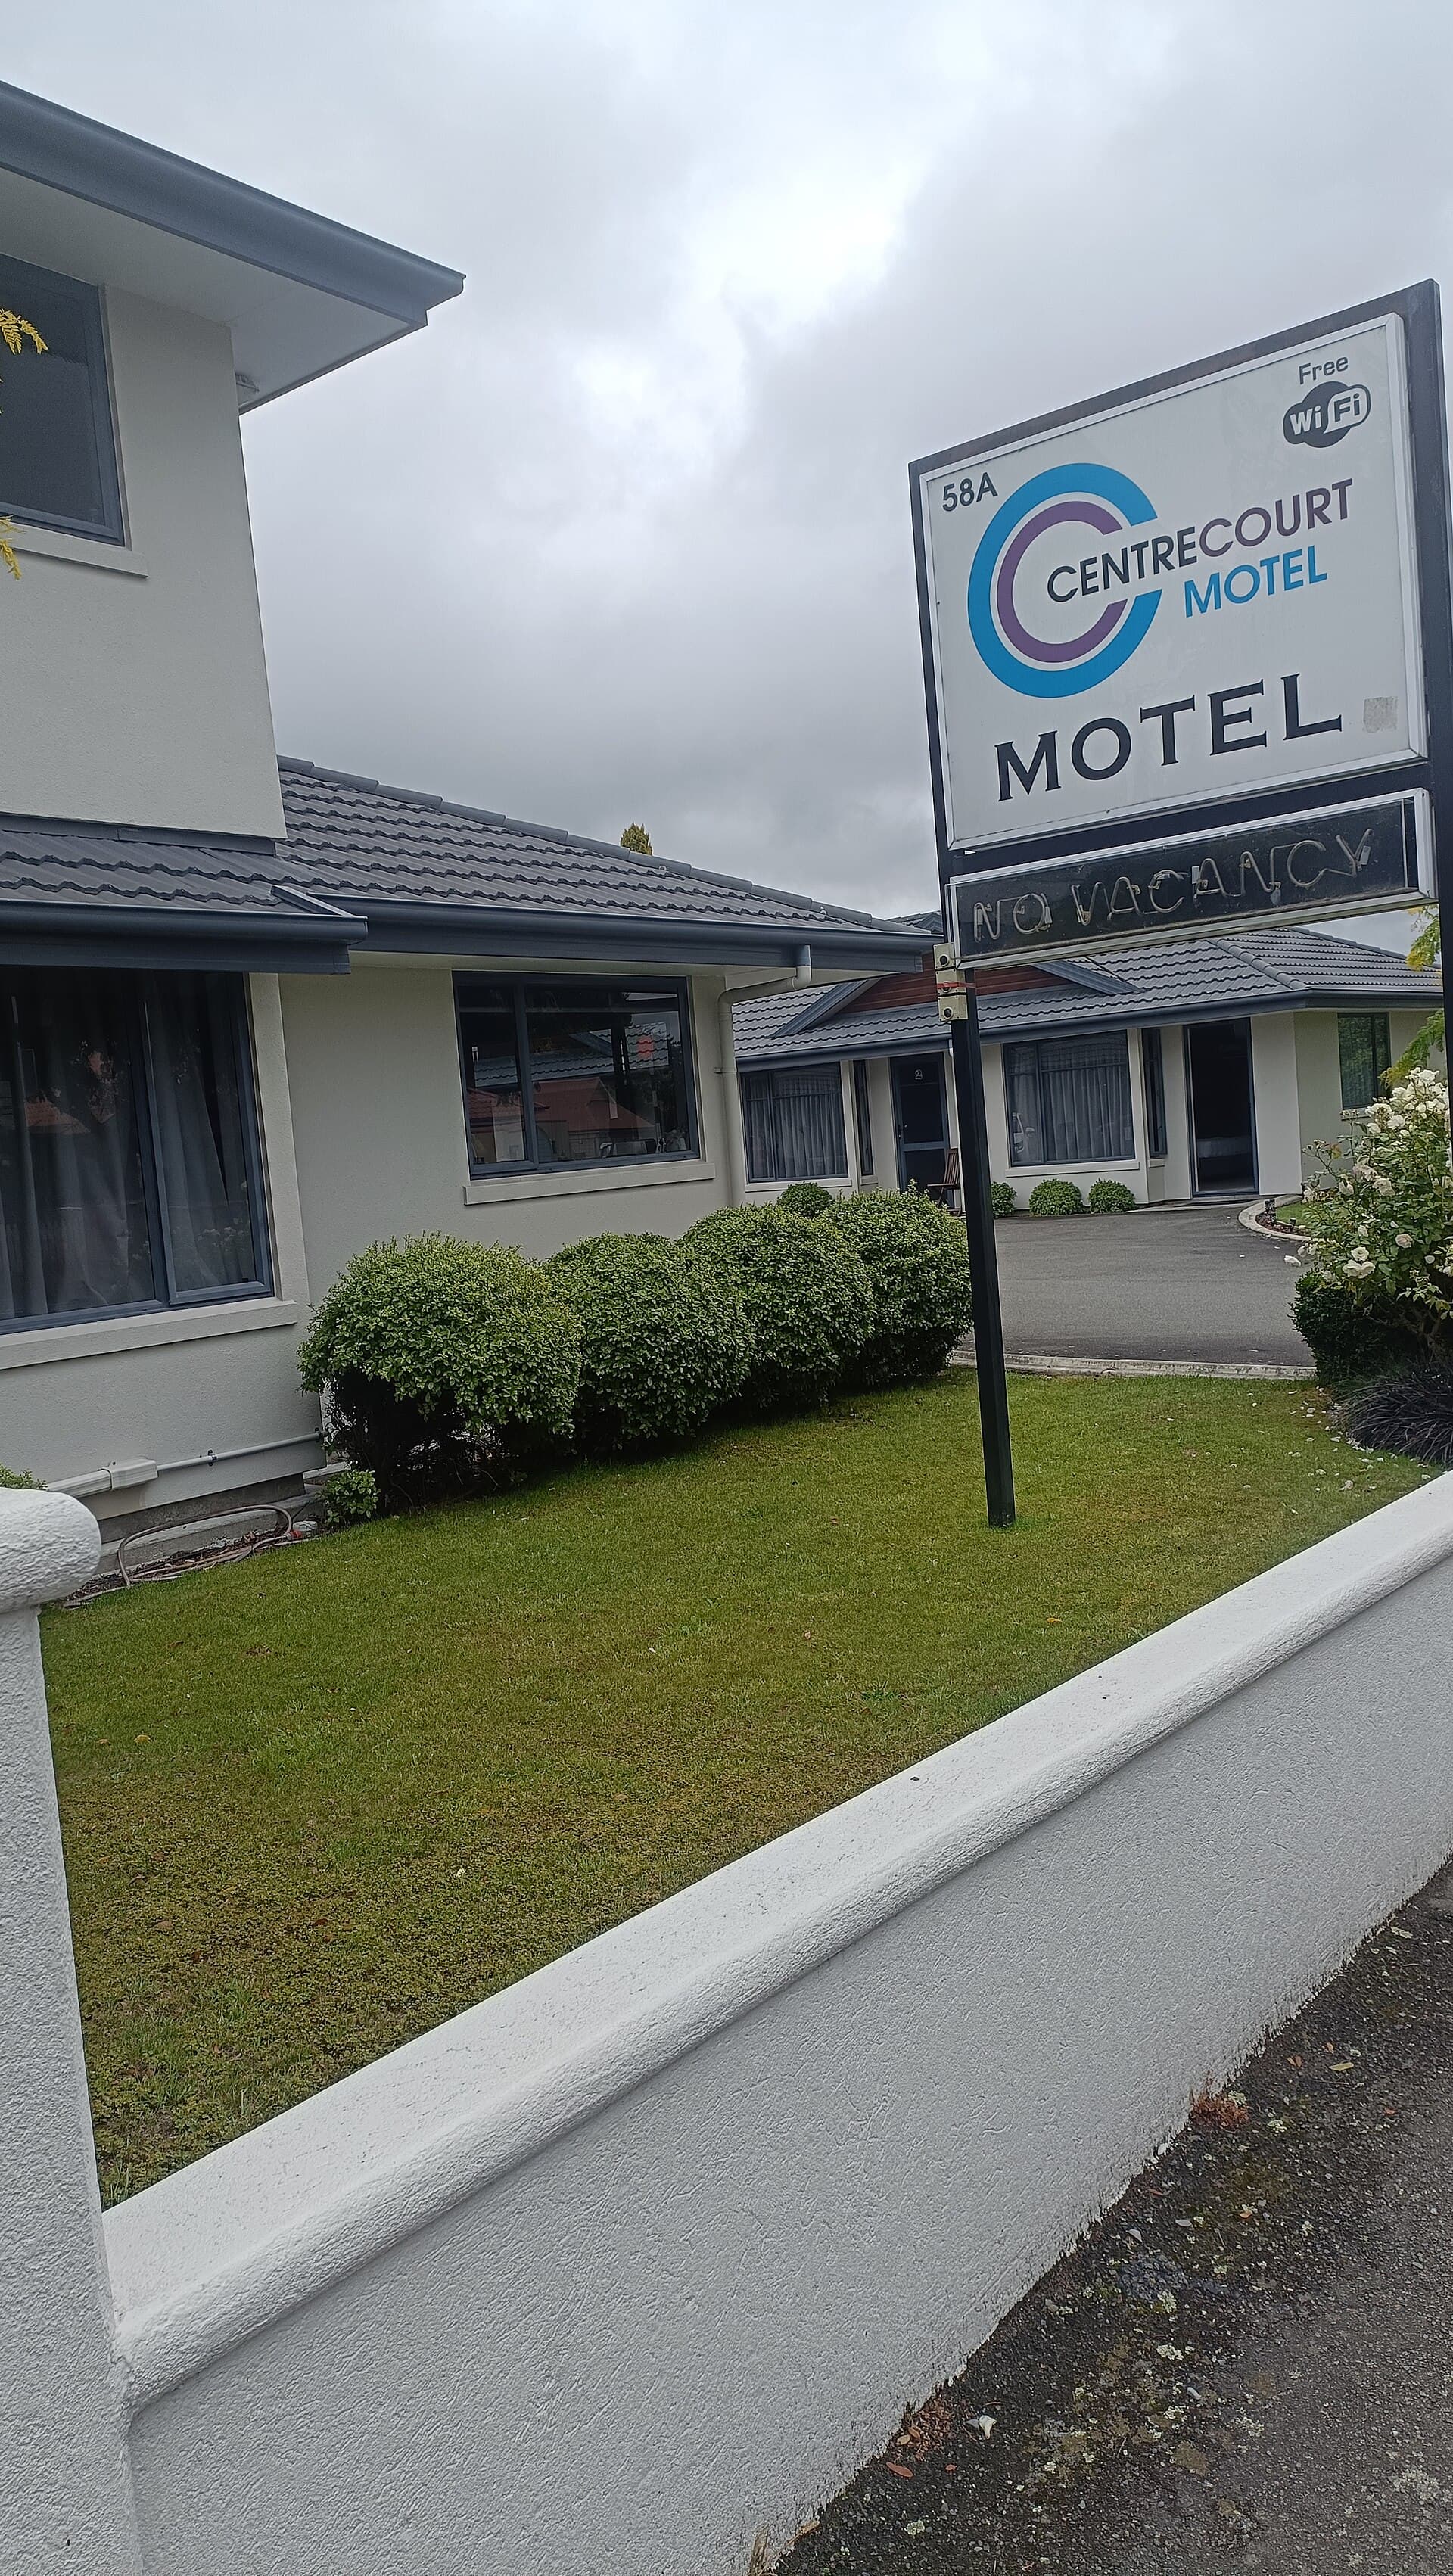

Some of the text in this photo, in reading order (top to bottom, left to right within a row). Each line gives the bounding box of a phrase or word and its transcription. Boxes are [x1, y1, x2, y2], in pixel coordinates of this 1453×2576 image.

[1299, 356, 1349, 384] Free
[942, 472, 998, 512] 58A
[1047, 478, 1353, 602] CENTRECOURT
[1184, 546, 1327, 618] MOTEL
[994, 674, 1343, 801] MOTEL
[974, 829, 1374, 943] NO VACANCY
